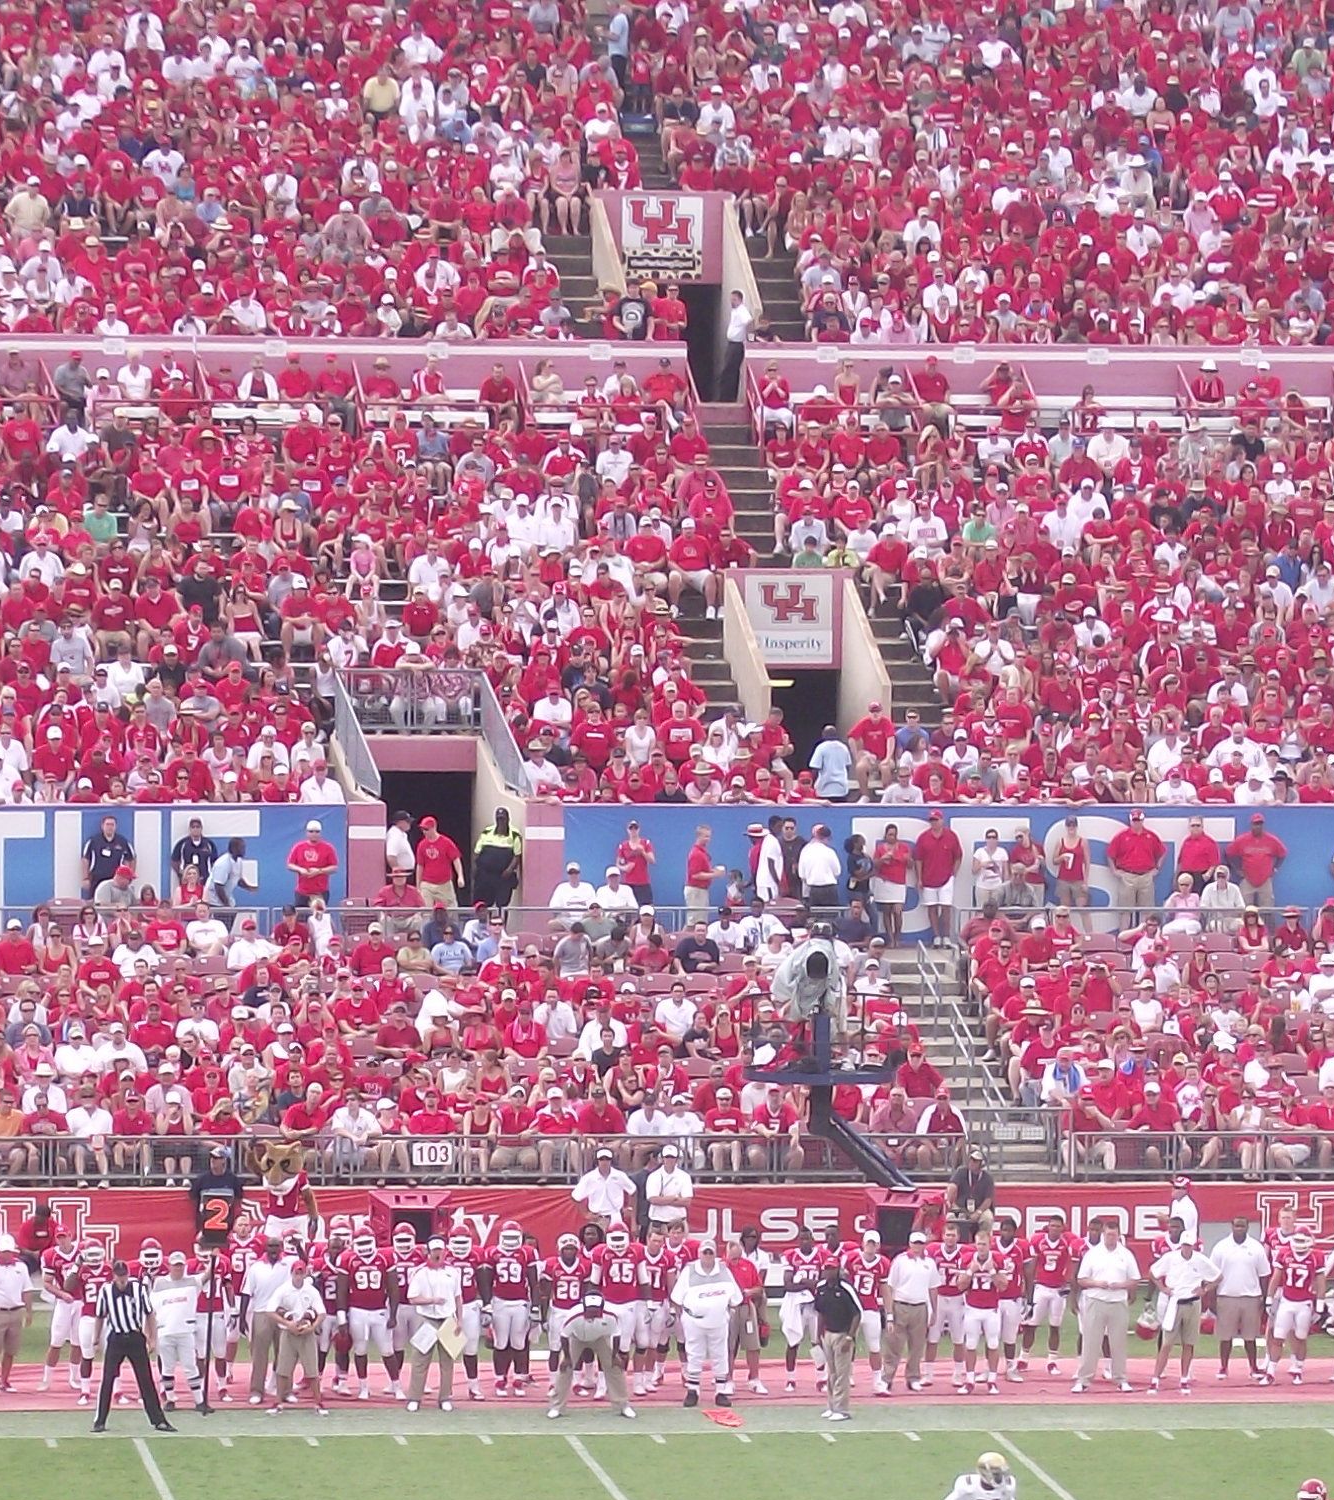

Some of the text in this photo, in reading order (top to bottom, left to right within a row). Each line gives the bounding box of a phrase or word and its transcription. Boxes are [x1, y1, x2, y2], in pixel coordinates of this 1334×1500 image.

[627, 198, 694, 247] UH
[759, 583, 819, 623] UH
[764, 636, 821, 651] Insperity
[416, 1145, 449, 1164] 103
[203, 1199, 230, 1230] 2
[687, 1207, 840, 1243] ULSE
[495, 1264, 522, 1283] 59
[608, 1265, 634, 1285] 45
[1285, 1266, 1309, 1289] 17
